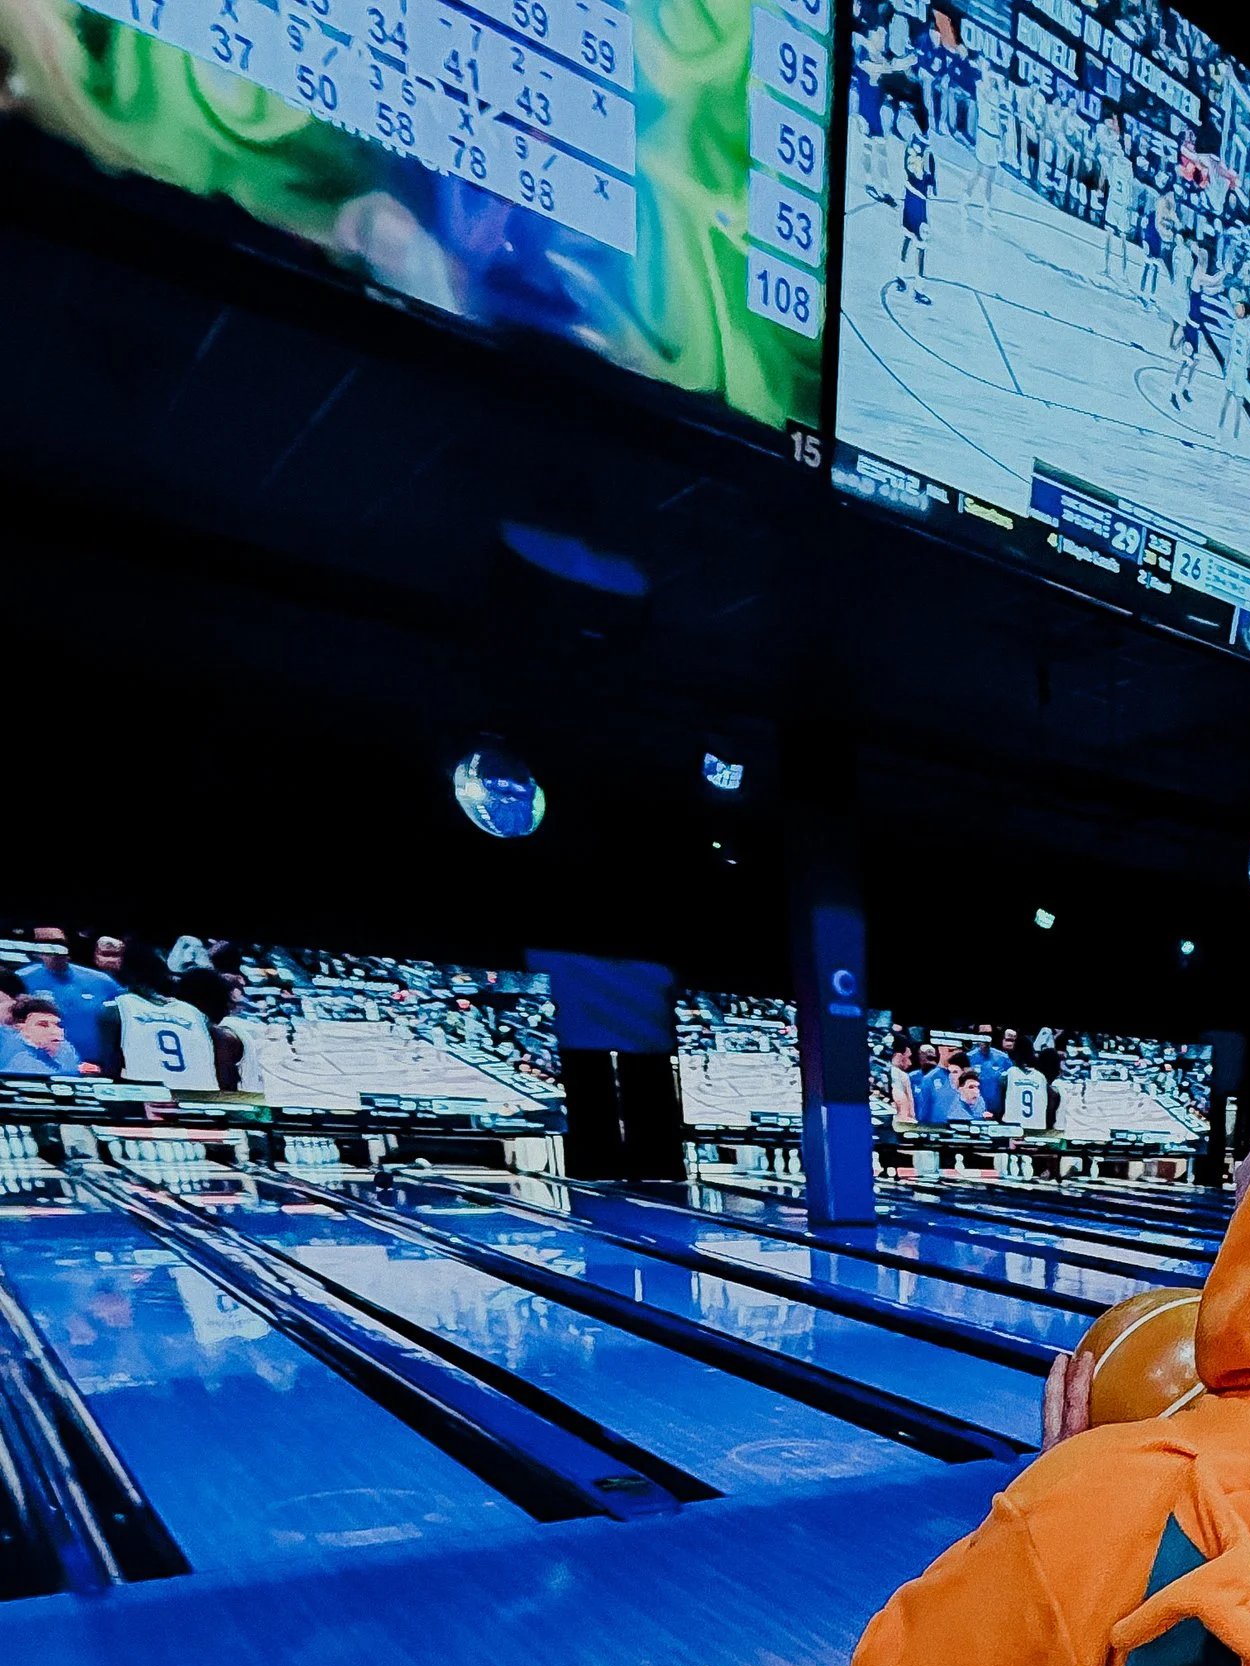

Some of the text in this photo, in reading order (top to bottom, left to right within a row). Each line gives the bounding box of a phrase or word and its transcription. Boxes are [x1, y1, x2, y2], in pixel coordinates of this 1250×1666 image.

[367, 7, 408, 54] 34
[512, 0, 549, 38] 59
[210, 24, 253, 71] 37
[581, 30, 617, 74] 59
[779, 42, 819, 97] 95
[297, 64, 338, 111] 50
[443, 49, 480, 93] 41
[1016, 50, 1053, 95] THE
[376, 100, 415, 147] 58
[516, 86, 552, 126] 43
[448, 134, 487, 180] 78
[777, 123, 816, 175] 59
[519, 170, 555, 212] 98
[776, 201, 813, 250] 53
[756, 269, 811, 323] 108
[790, 431, 821, 468] 15
[1111, 522, 1141, 554] 29
[1179, 552, 1202, 581] 26
[157, 1029, 187, 1072] 9
[1022, 1090, 1034, 1118] 9
